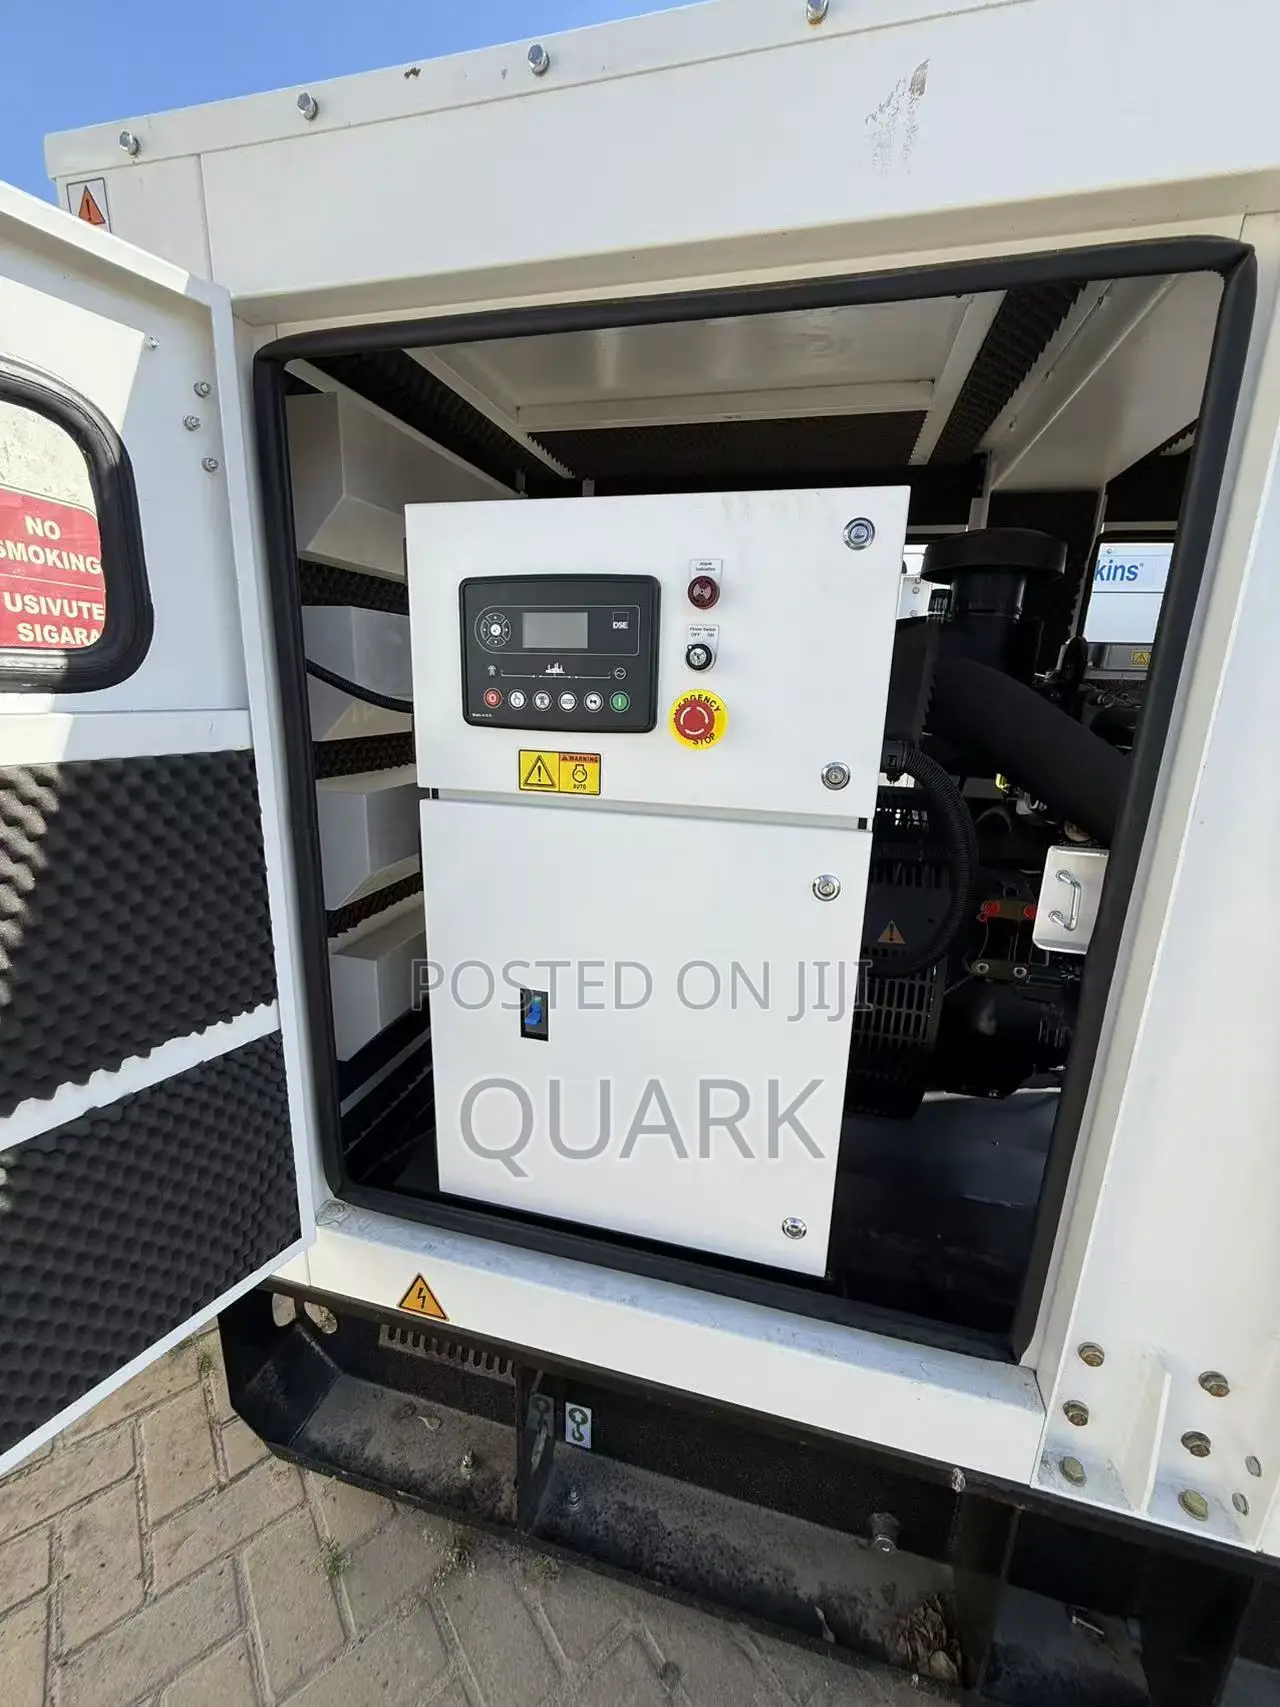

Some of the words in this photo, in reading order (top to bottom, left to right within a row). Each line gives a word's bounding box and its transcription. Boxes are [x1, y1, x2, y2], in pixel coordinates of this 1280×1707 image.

[25, 515, 61, 541] NO
[1095, 560, 1139, 581] kins
[4, 592, 105, 621] USIVUTE
[613, 621, 629, 629] DSE
[692, 732, 716, 745] STOP
